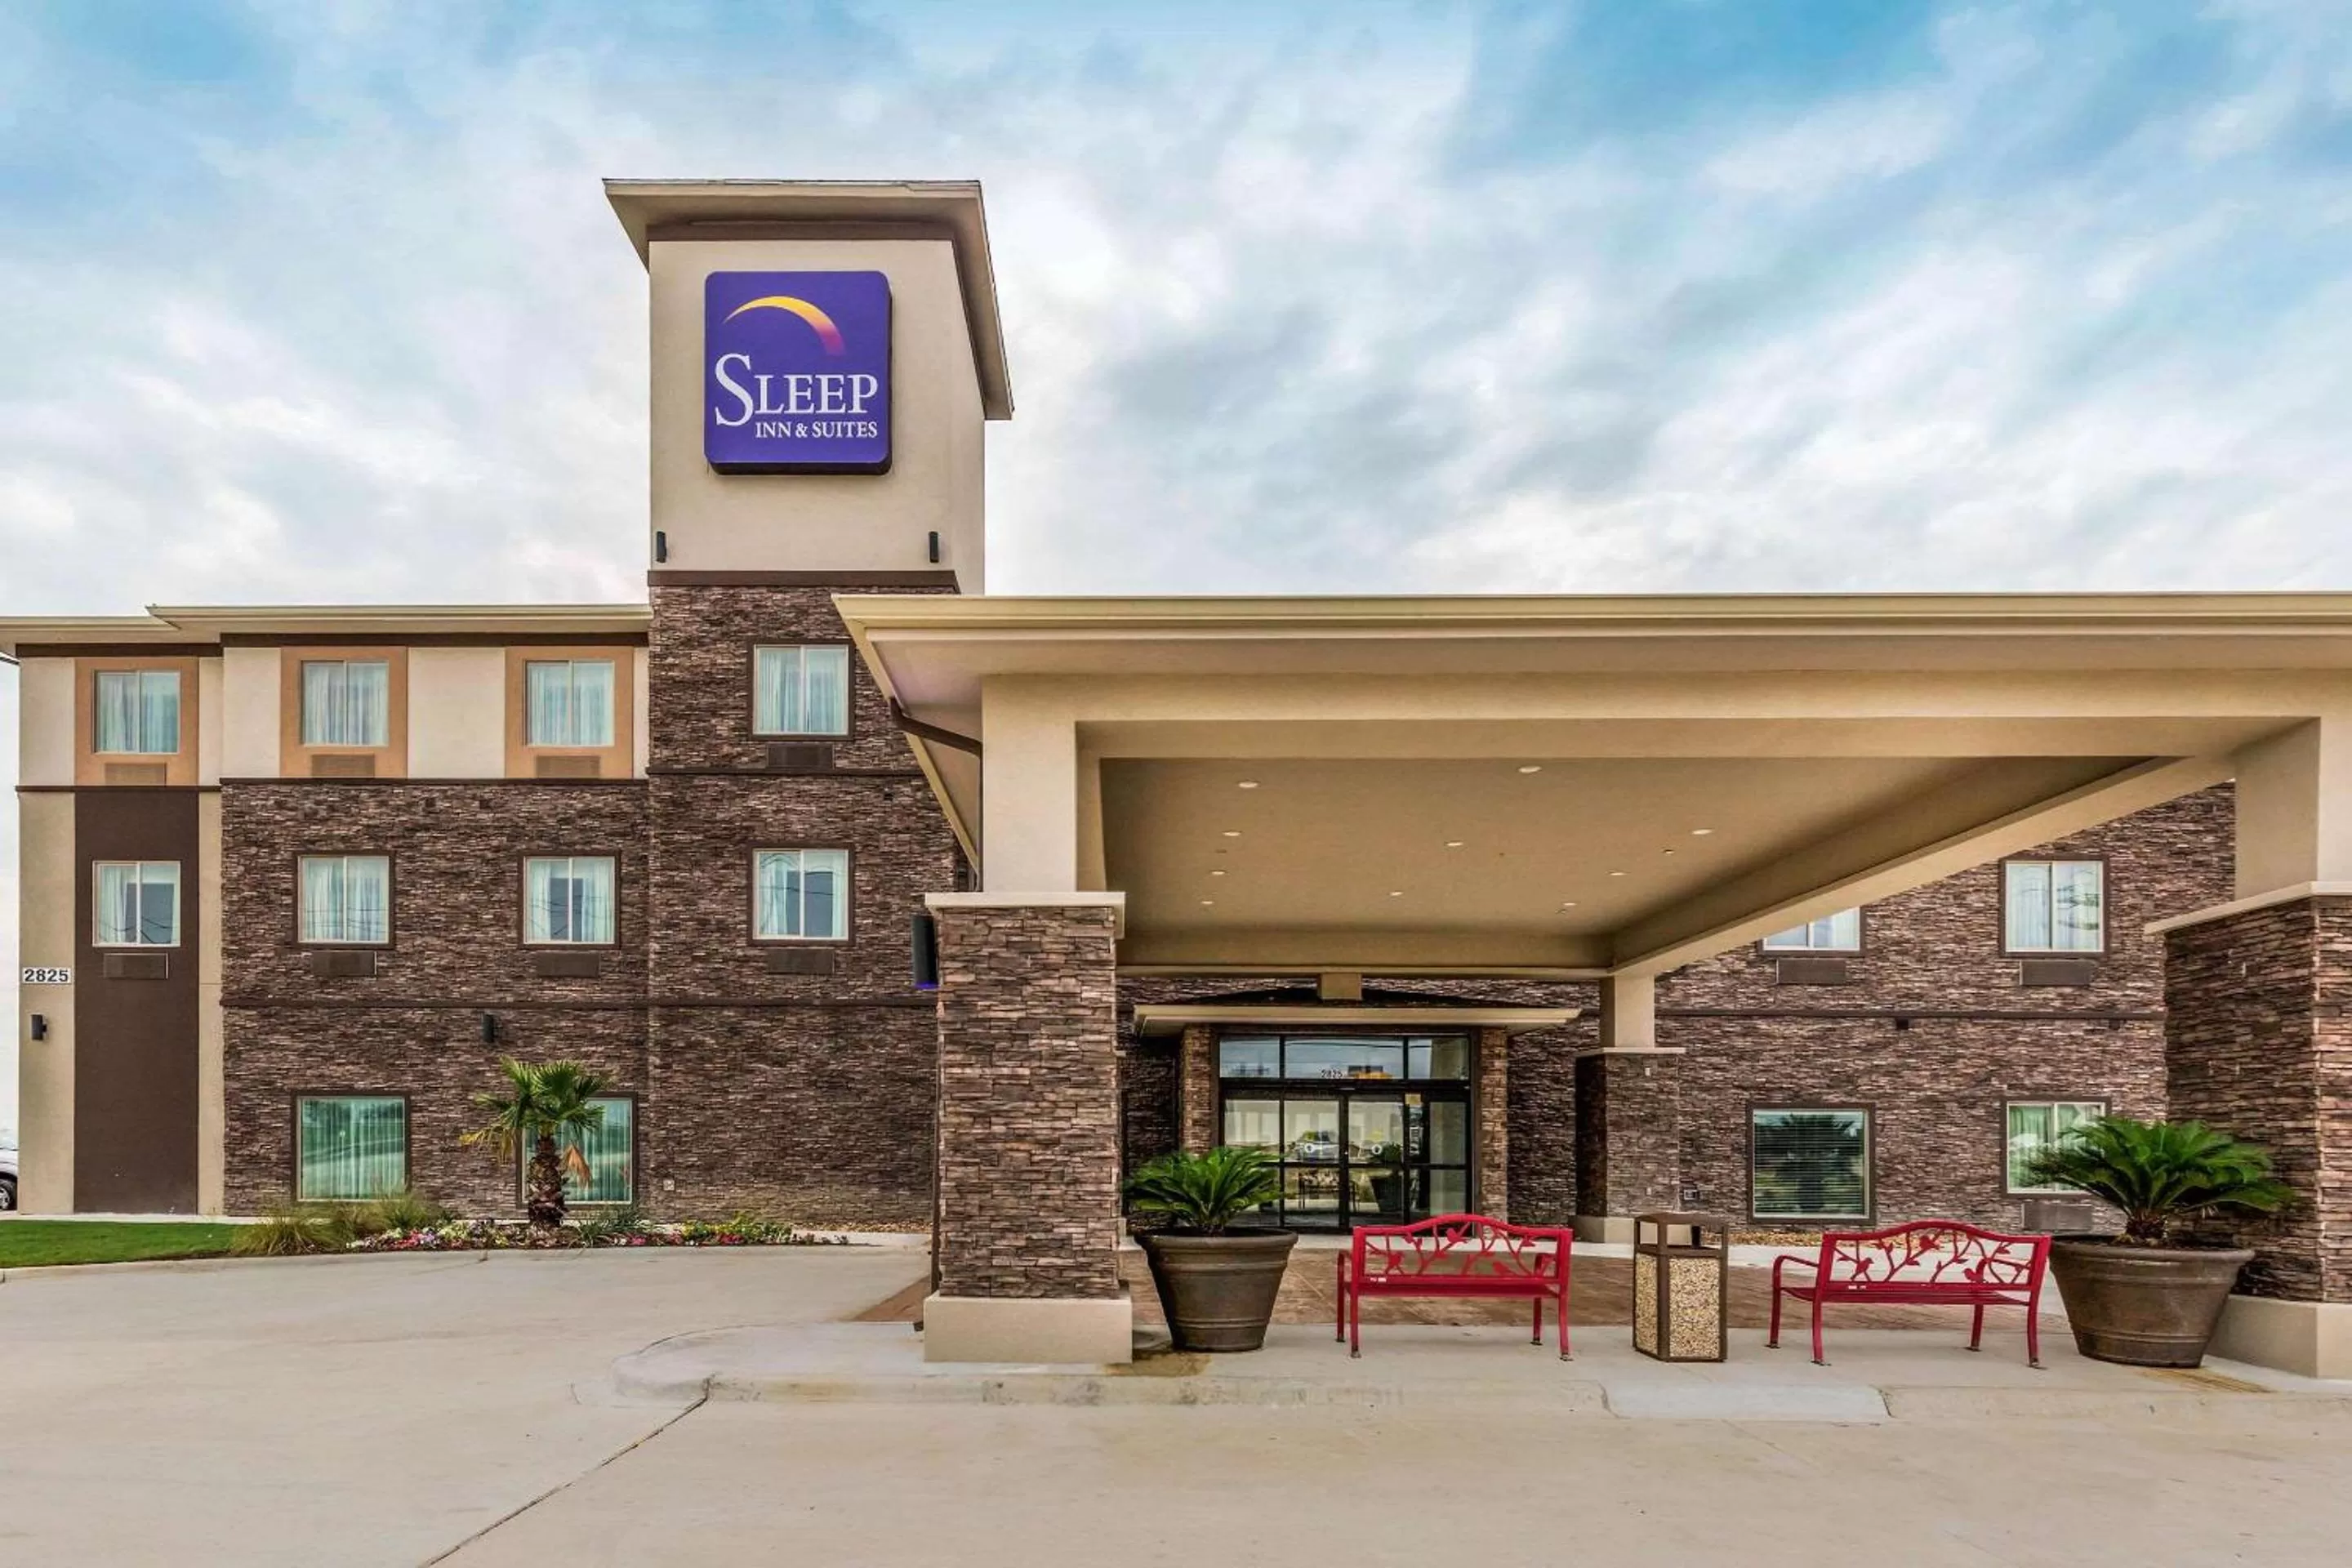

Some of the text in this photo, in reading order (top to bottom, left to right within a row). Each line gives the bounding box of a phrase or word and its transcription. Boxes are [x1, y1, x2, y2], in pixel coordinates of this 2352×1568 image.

[715, 353, 878, 426] SLEEP
[755, 421, 878, 439] INN & SUITES
[24, 969, 69, 982] 2825
